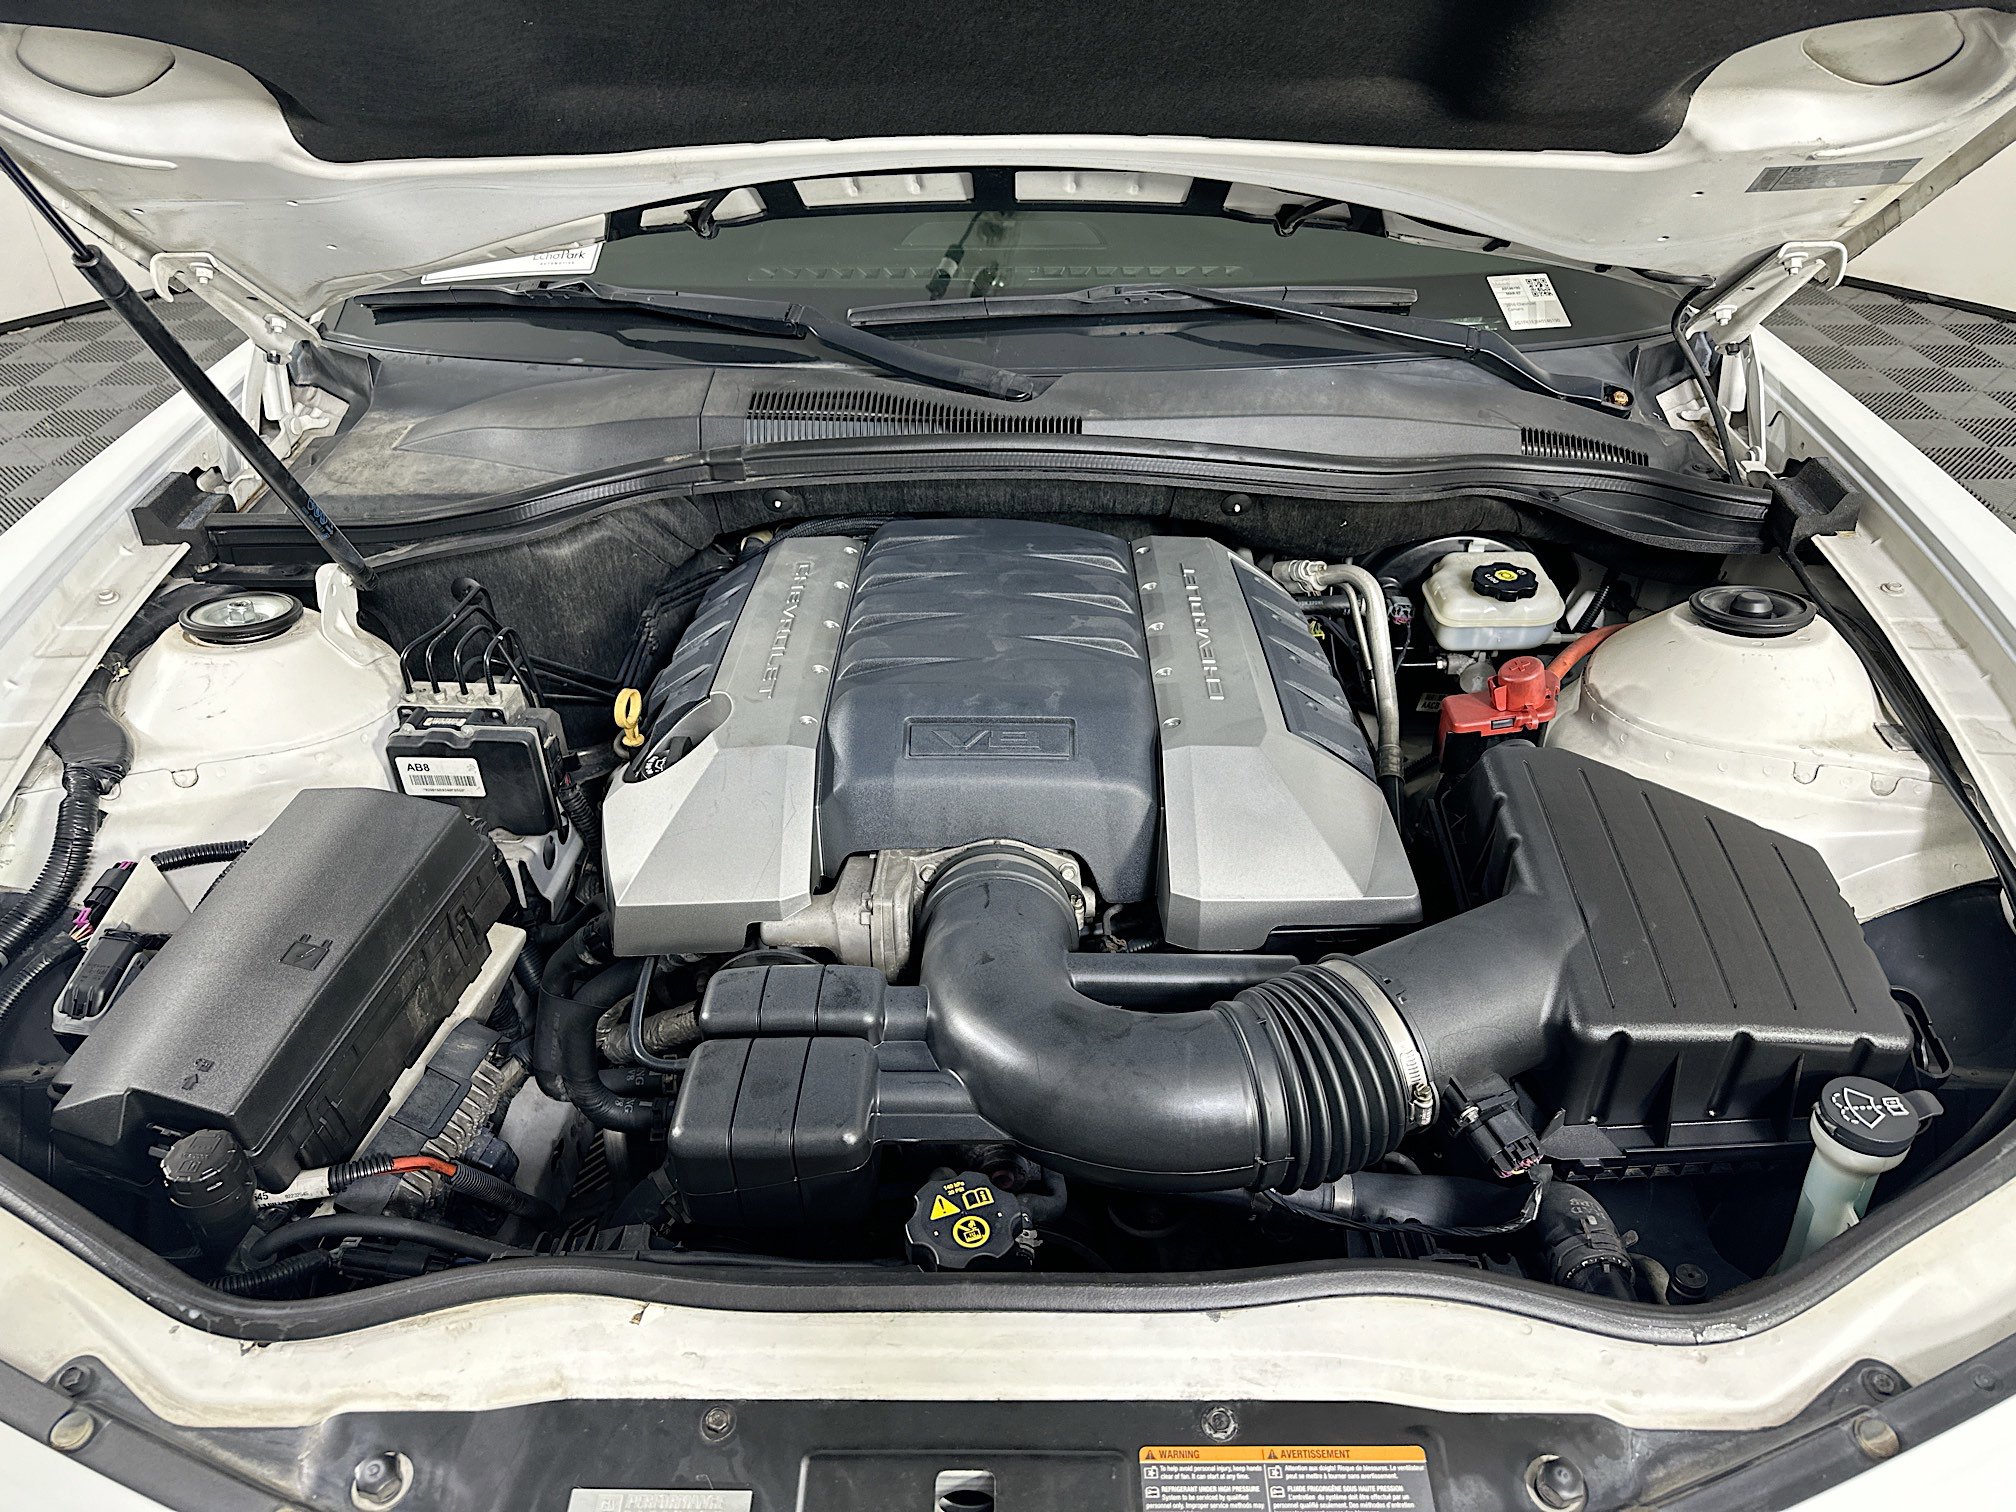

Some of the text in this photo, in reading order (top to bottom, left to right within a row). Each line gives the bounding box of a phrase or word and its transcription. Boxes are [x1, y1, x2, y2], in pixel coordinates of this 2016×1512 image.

[759, 562, 811, 699] CHEVROLET
[1180, 563, 1225, 700] CHEVROLET
[930, 729, 1042, 751] V8
[407, 763, 430, 772] AB8
[1158, 1449, 1200, 1459] WARNING
[1280, 1449, 1350, 1459] AVERTISSEMENT
[1167, 1464, 1178, 1472] help
[1233, 1465, 1246, 1473] keep
[1226, 1473, 1236, 1481] any
[1161, 1485, 1260, 1493] REFRIGERANT UNDER HIGH PRESSURE
[1306, 1484, 1342, 1492] FRIGORIGÈNE
[1161, 1494, 1182, 1502] System
[1218, 1494, 1226, 1502] by
[1226, 1494, 1249, 1502] qualified
[1392, 1494, 1401, 1502] par
[1146, 1502, 1172, 1510] personnel
[1185, 1502, 1209, 1510] Improper
[1253, 1502, 1265, 1510] may
[1273, 1502, 1299, 1510] personnel
